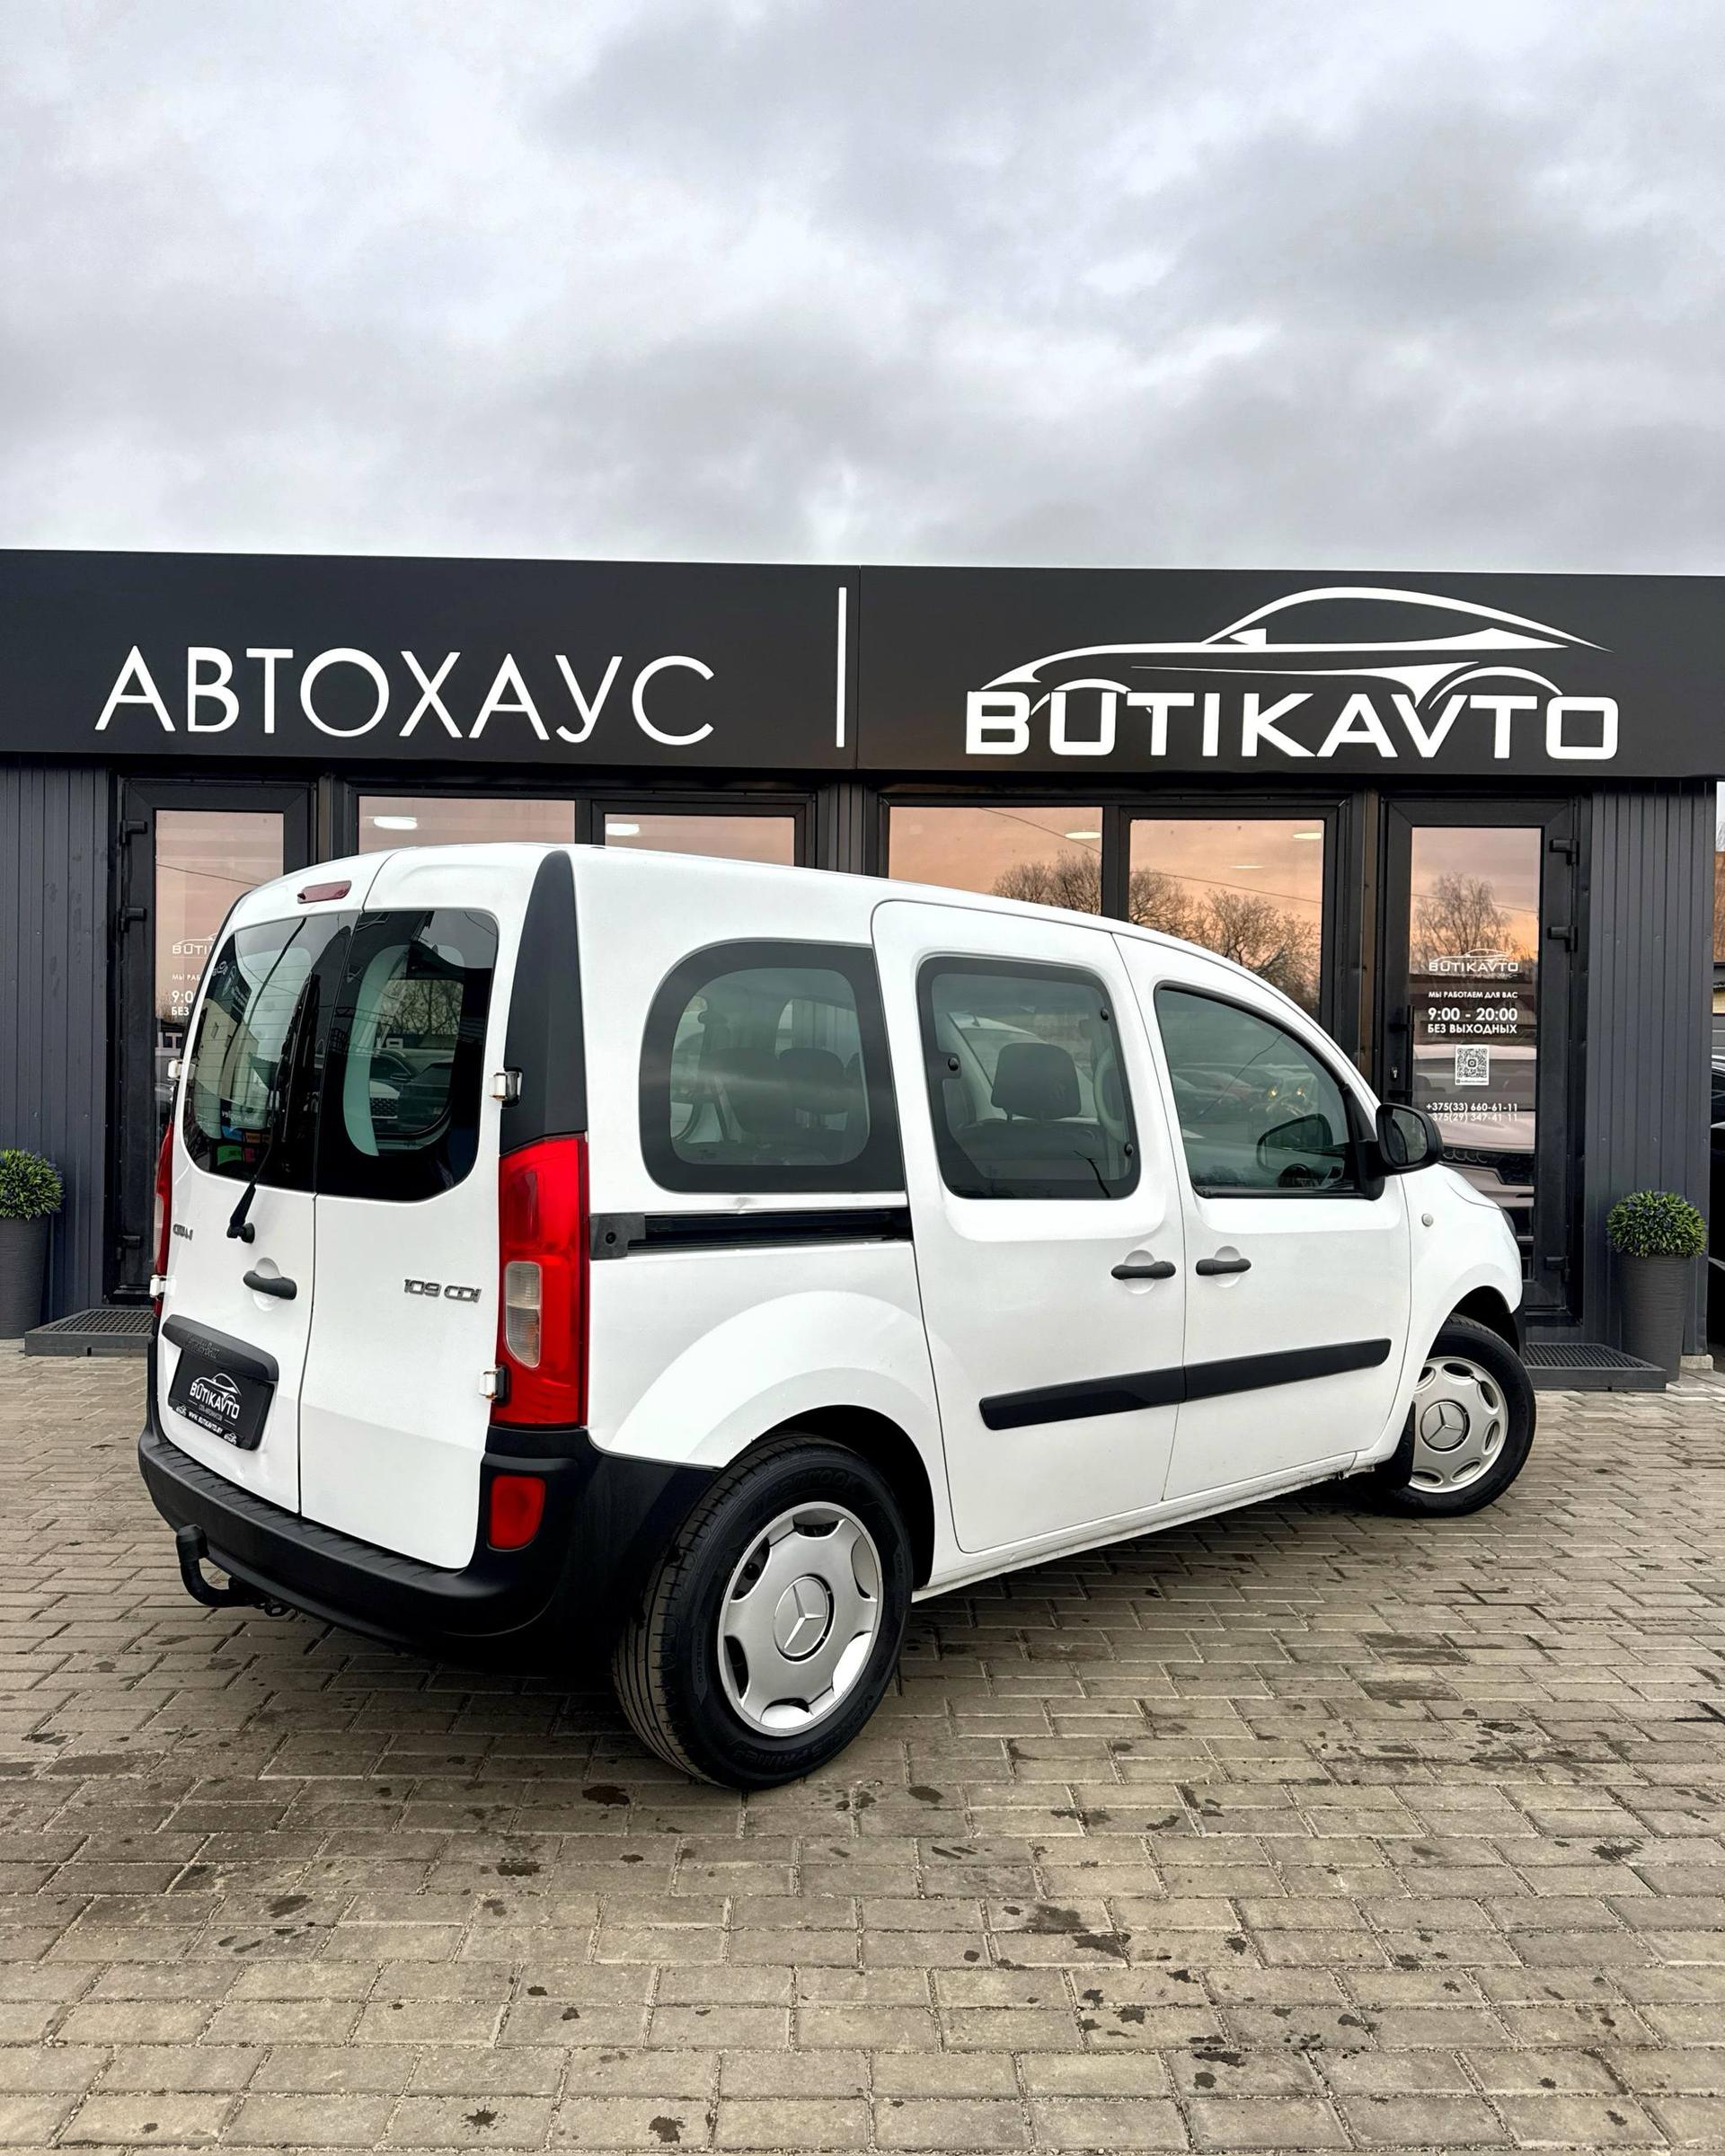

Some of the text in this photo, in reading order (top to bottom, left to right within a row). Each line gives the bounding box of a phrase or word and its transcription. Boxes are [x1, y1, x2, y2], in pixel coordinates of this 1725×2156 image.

[94, 644, 716, 747] АВТОХАУС
[963, 689, 1621, 762] BUTIKAVTO
[172, 944, 213, 955] BUTI
[1428, 961, 1519, 973] BUTIKAVTO
[171, 989, 196, 1004] 9:0
[1428, 991, 1519, 999] МЫ РАБОТАЕМ ДЛЯ ВАС
[171, 1005, 190, 1016] БЕЗ
[1428, 1007, 1461, 1021] 9:00
[1475, 1007, 1518, 1021] 20:00
[1427, 1023, 1518, 1035] БЕЗ ВЫХОДНЫХ
[1426, 1101, 1518, 1113] +375(33) 660-61-11
[1430, 1112, 1469, 1124] 375(29)
[403, 1278, 482, 1303] 109 CDI
[189, 1381, 241, 1419] BUTIKAVTO
